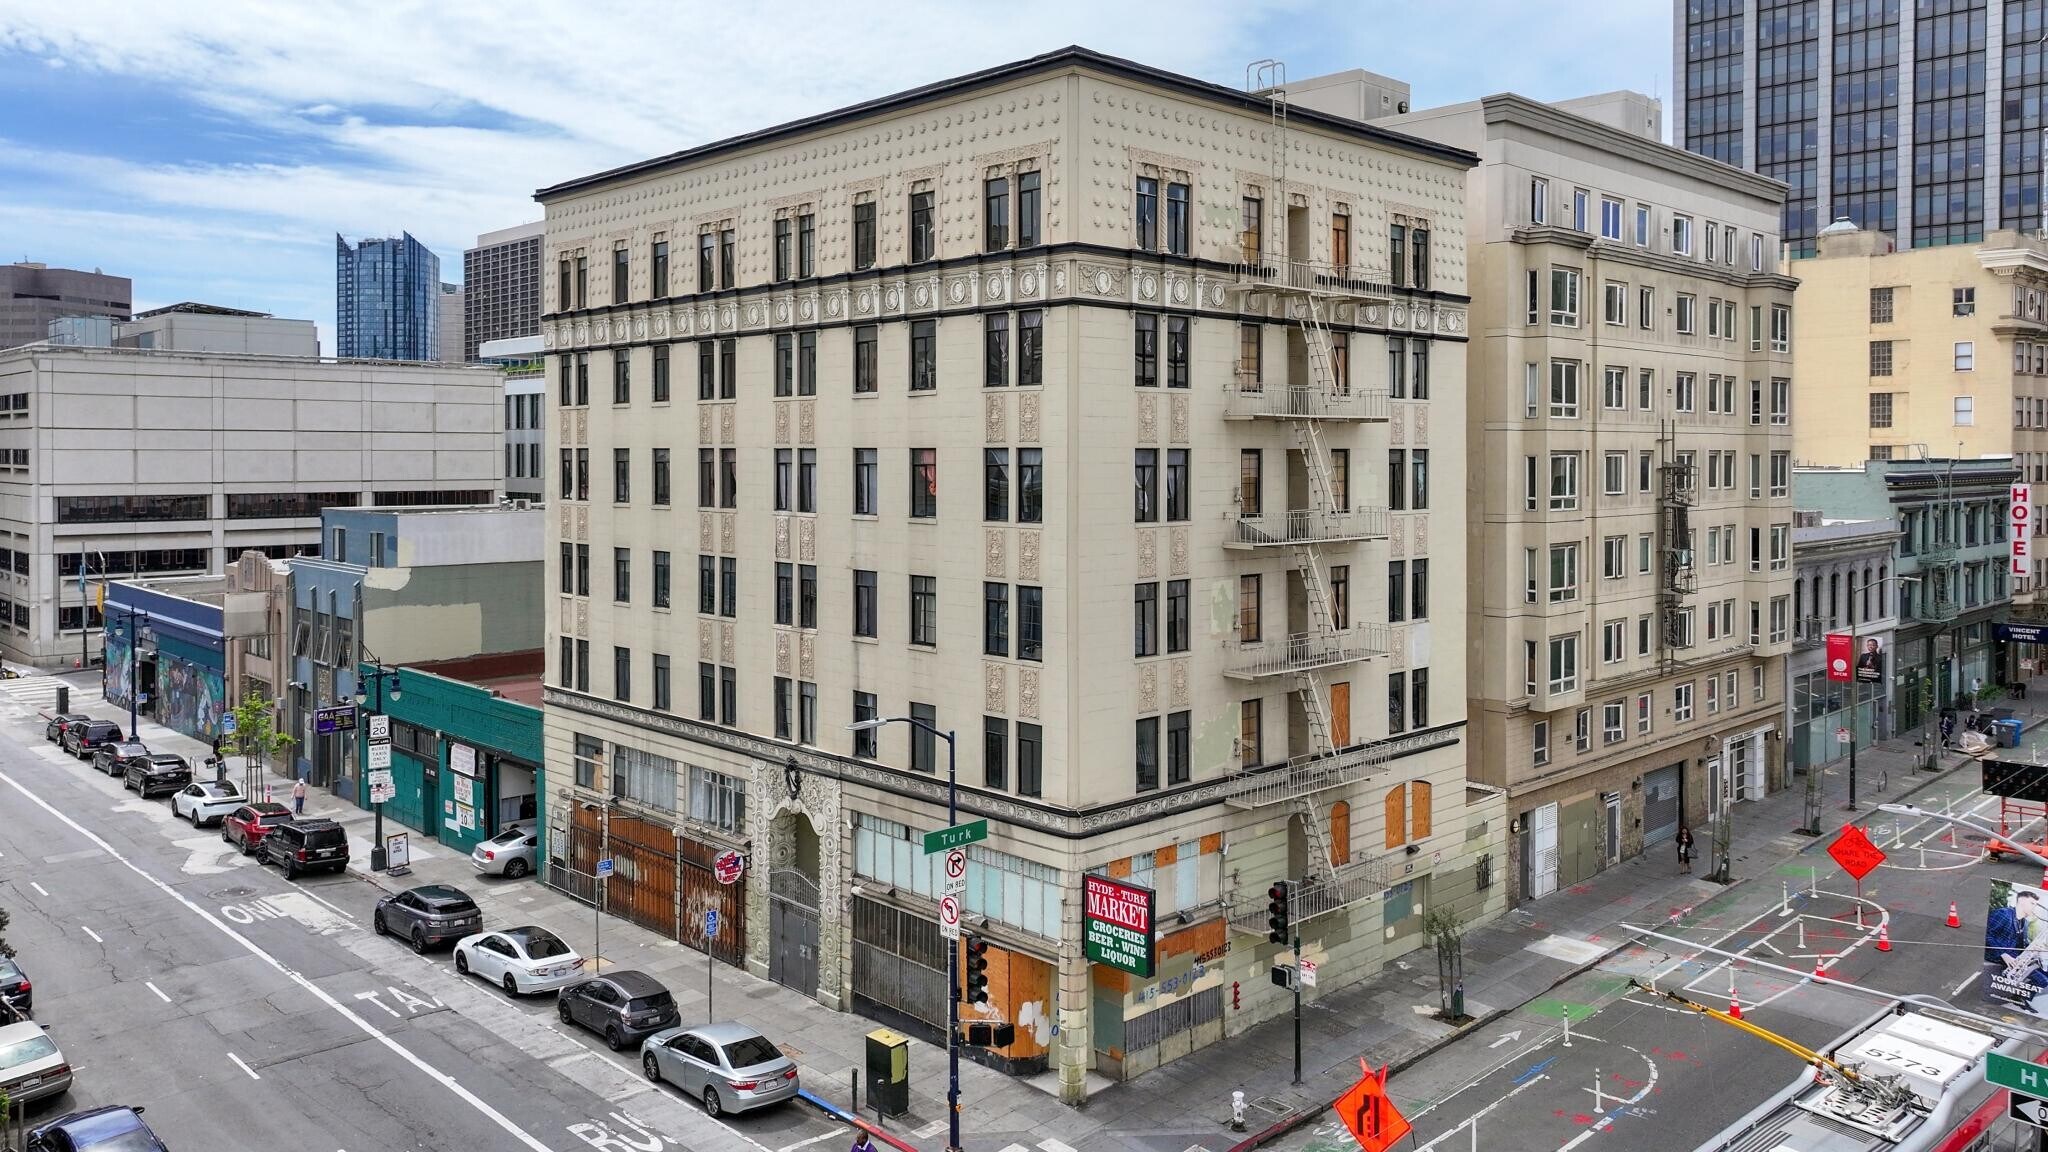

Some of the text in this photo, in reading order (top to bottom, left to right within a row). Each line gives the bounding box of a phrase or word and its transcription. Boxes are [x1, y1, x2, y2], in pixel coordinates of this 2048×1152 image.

[2012, 488, 2028, 573] HOTEL
[372, 727, 387, 735] 20
[941, 829, 971, 845] Turk
[1835, 848, 1880, 860] SHARE THE
[1845, 859, 1867, 868] ROAD
[946, 879, 965, 891] ON RED
[1088, 881, 1114, 897] HYDE
[1120, 890, 1147, 906] TURK
[220, 899, 291, 924] ONL
[1087, 891, 1148, 929] MARKET
[941, 924, 958, 937] ON RED
[1092, 920, 1145, 945] GROCERIES
[1088, 930, 1114, 948] BEER
[1121, 941, 1147, 959] WINE
[1101, 947, 1136, 967] LIQUOR
[1990, 974, 2044, 994] YOUR SEAT
[1990, 982, 2031, 998] AWAITS!
[1865, 1048, 1941, 1076] 5773
